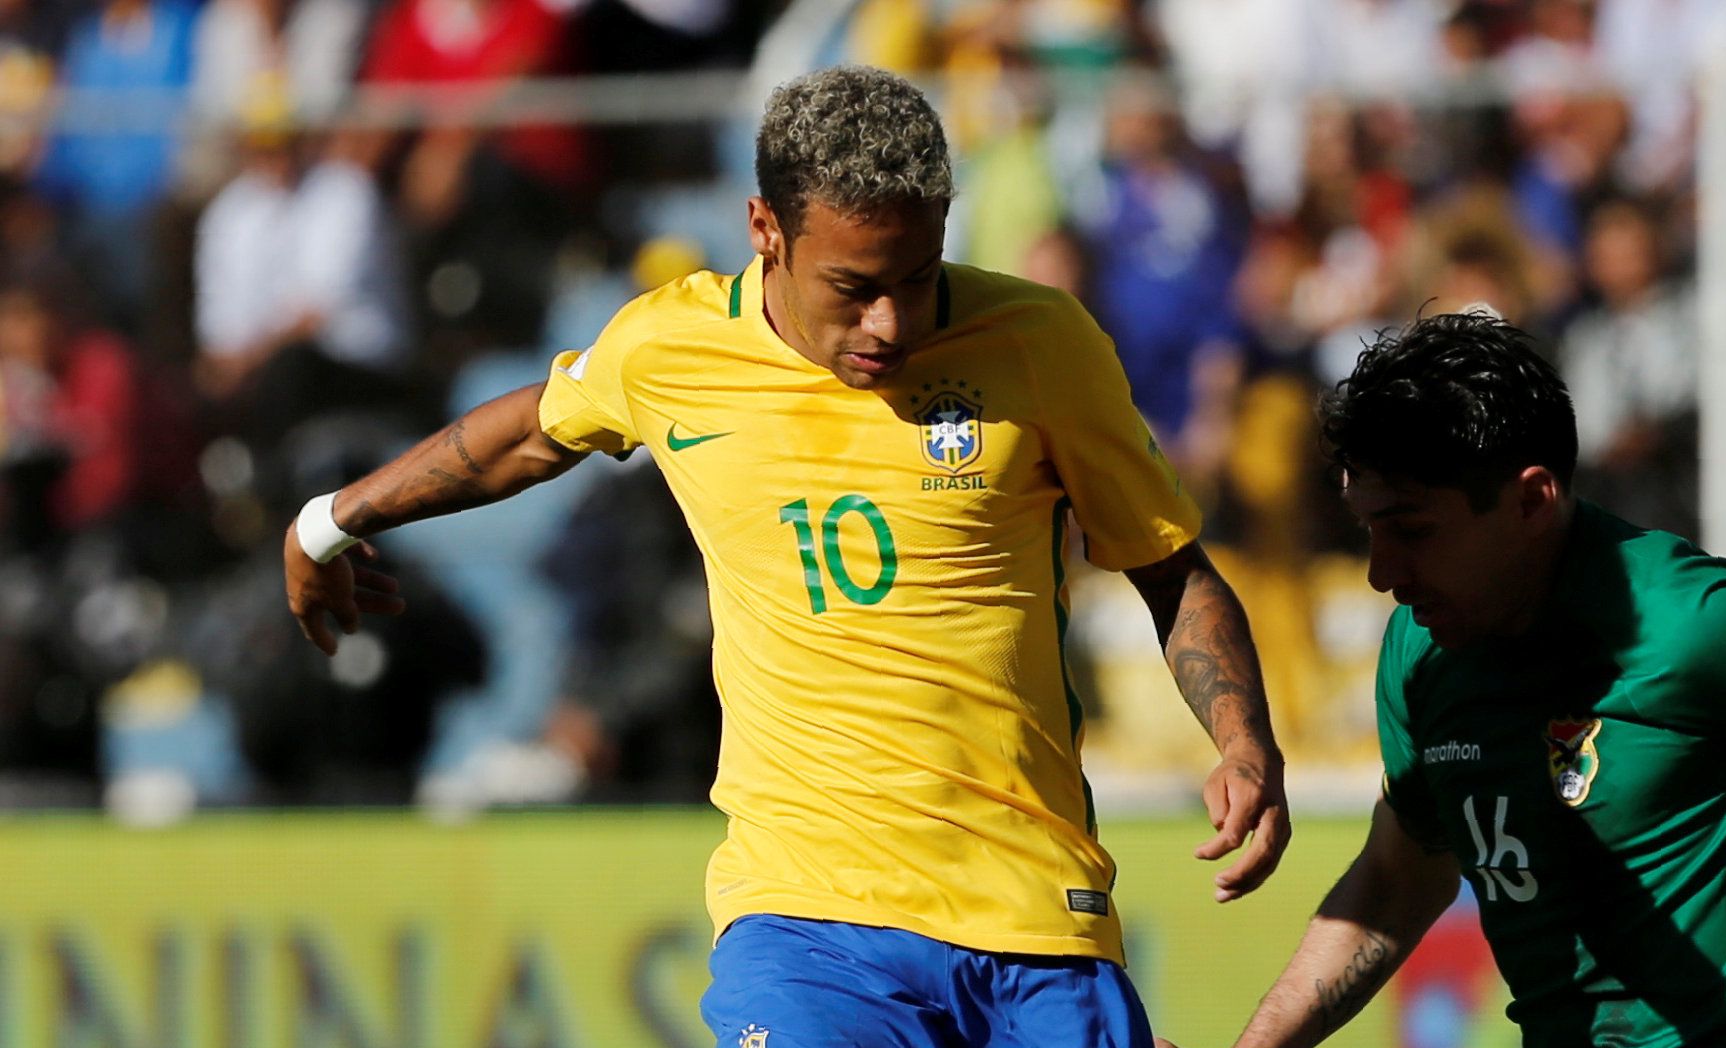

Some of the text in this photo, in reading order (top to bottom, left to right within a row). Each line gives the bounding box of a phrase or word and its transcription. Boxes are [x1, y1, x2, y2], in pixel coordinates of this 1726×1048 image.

[939, 425, 960, 435] CBF
[922, 476, 988, 491] BRASIL
[780, 494, 897, 615] 10
[1463, 795, 1539, 902] 16
